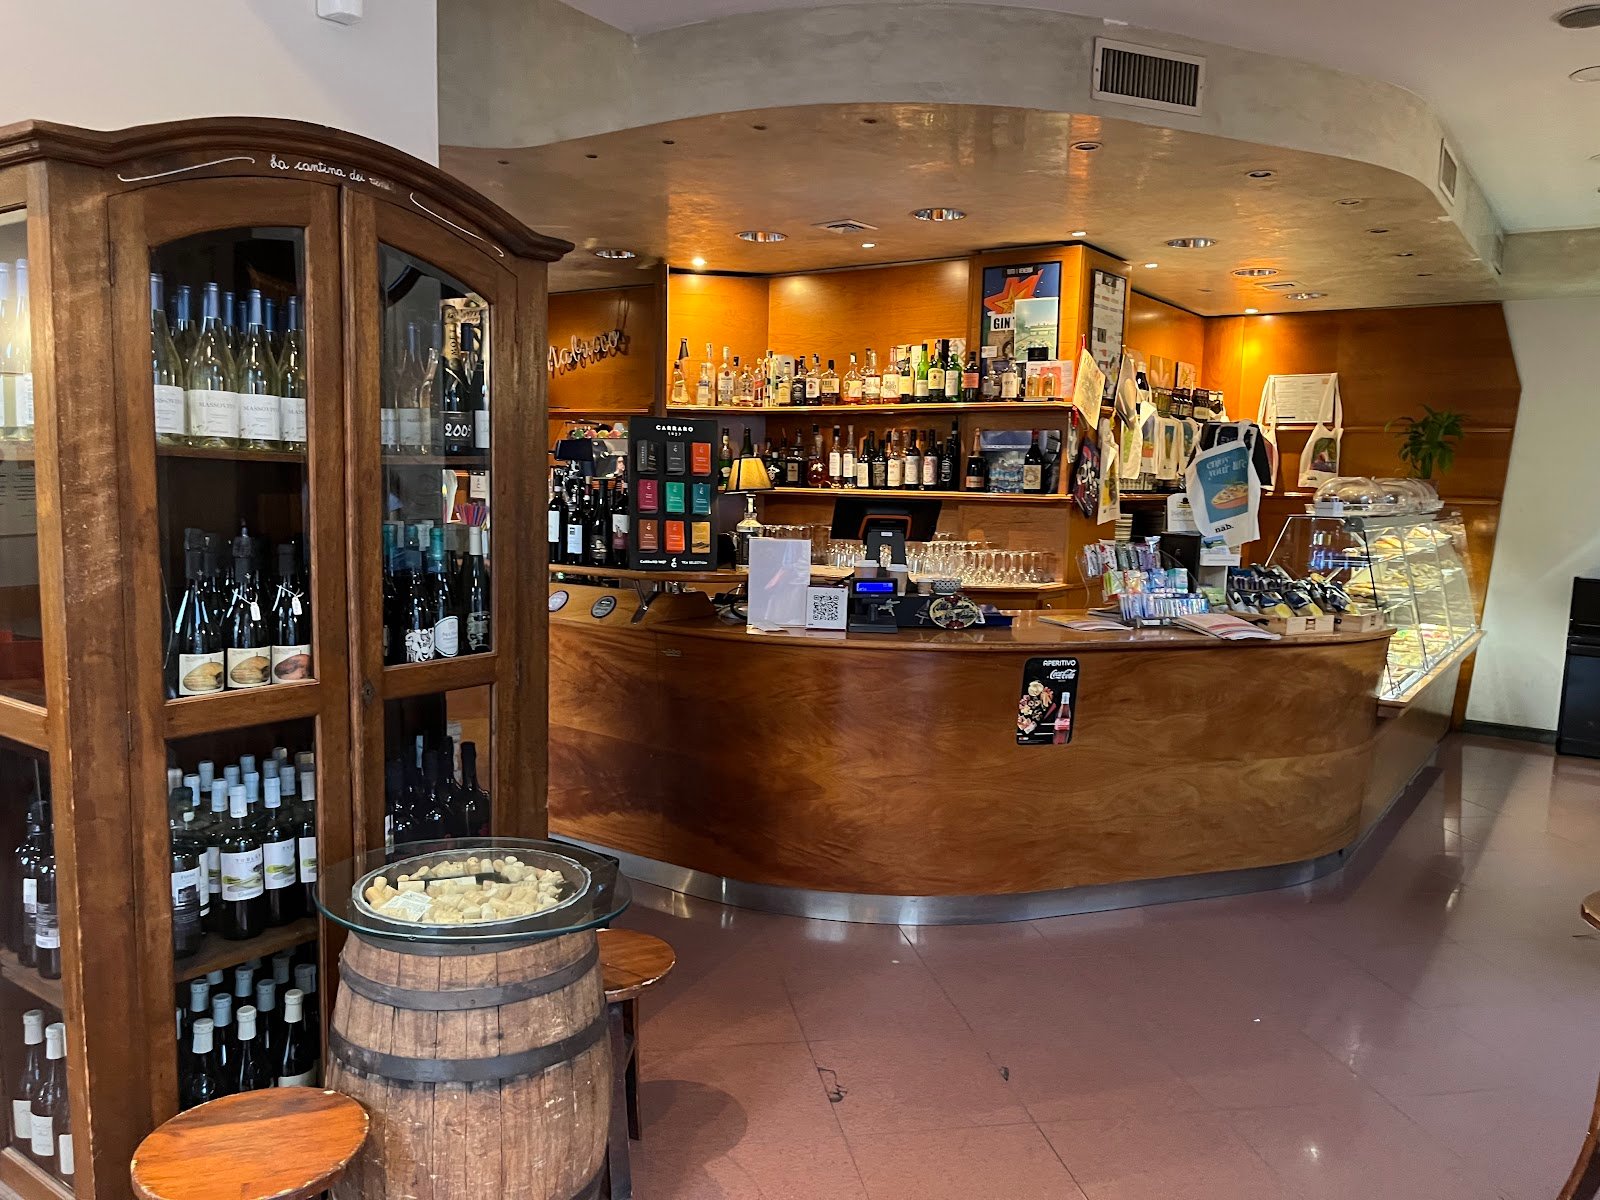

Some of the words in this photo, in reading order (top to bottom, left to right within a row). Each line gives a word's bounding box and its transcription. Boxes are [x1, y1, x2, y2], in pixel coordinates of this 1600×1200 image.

[270, 154, 289, 170] La
[294, 161, 346, 178] cantina
[350, 169, 366, 182] dei
[993, 317, 1011, 330] GIN
[655, 424, 694, 433] CARRARO
[1043, 659, 1076, 667] APERITIVO
